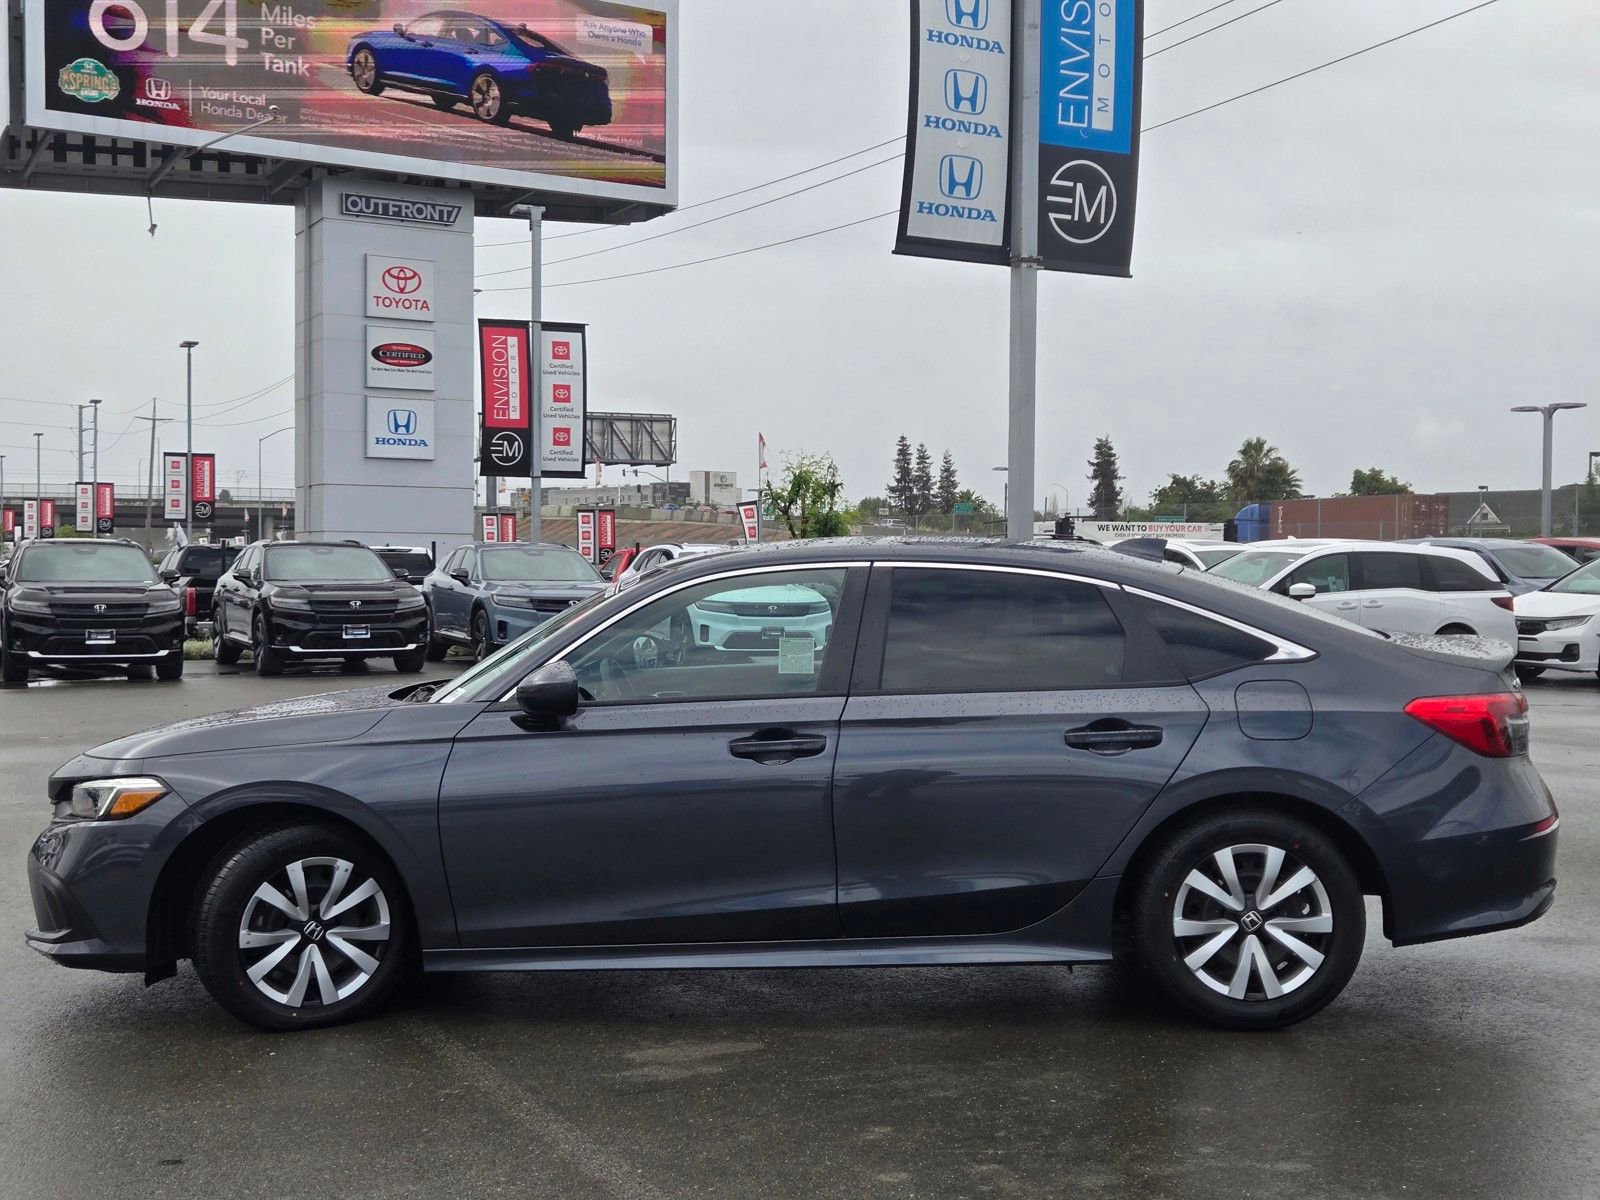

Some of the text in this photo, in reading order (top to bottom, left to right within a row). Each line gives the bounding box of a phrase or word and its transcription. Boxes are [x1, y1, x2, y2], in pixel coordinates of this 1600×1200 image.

[261, 3, 317, 29] Miles
[261, 27, 296, 49] Per
[926, 29, 1006, 55] HONDA
[262, 52, 312, 77] Tank
[136, 98, 181, 111] HONDA
[200, 86, 266, 106] Your Local
[201, 102, 243, 119] Honda
[924, 115, 1003, 138] HONDA
[917, 201, 998, 223] HONDA
[373, 295, 430, 311] TOYOTA
[491, 335, 509, 420] ENVISION
[375, 437, 429, 447] HONDA
[1097, 524, 1111, 532] WE
[1112, 524, 1136, 532] WANT
[1136, 524, 1147, 532] TO
[1148, 524, 1164, 532] BUY
[1165, 524, 1186, 532] YOUR
[1187, 525, 1203, 533] CAR
